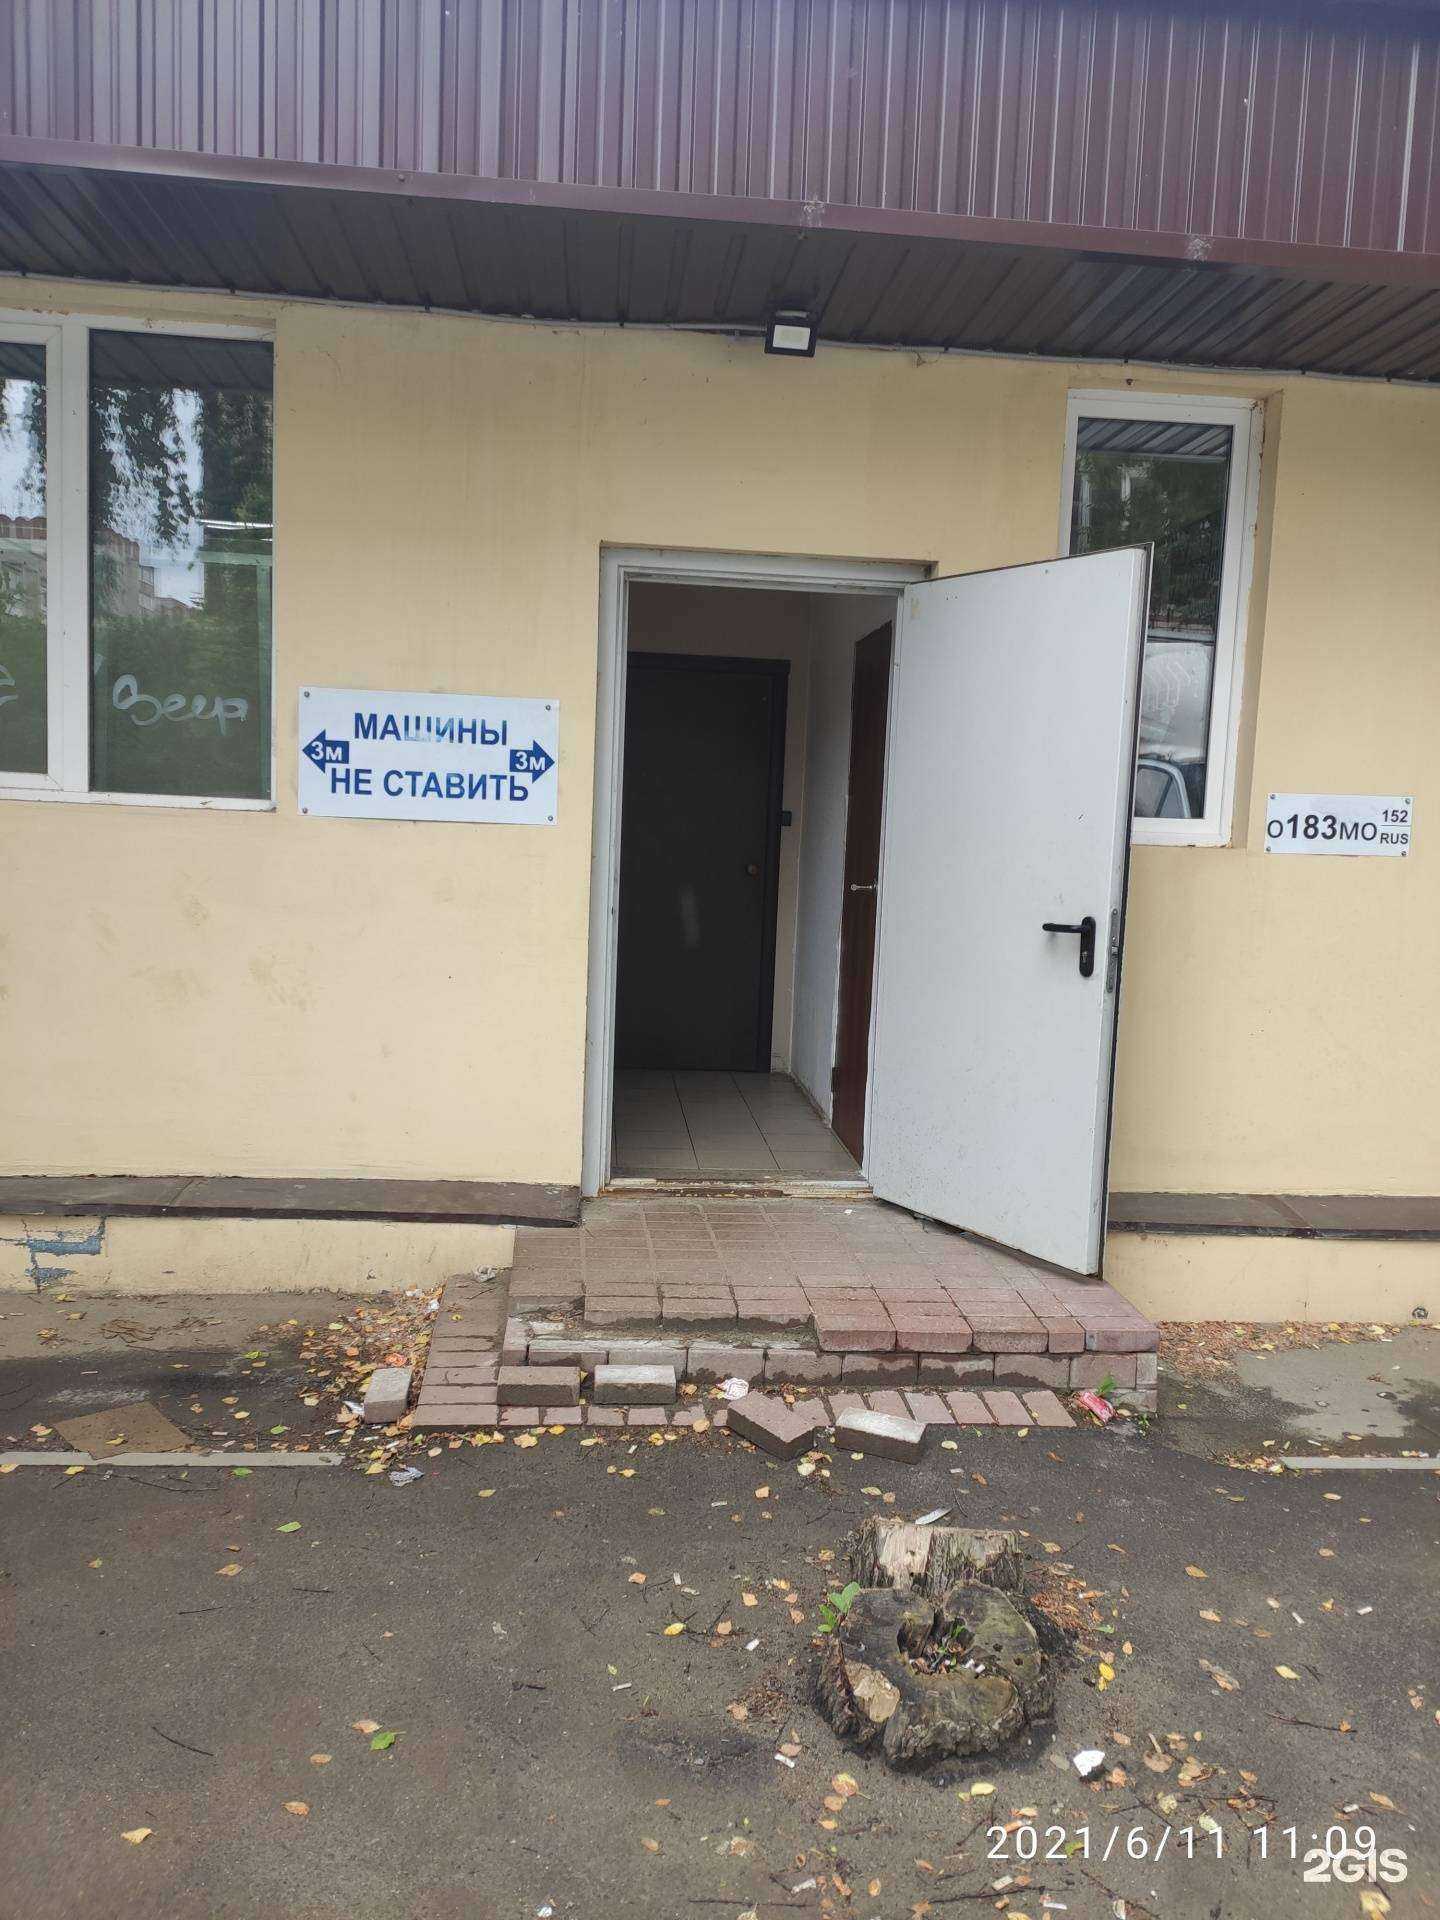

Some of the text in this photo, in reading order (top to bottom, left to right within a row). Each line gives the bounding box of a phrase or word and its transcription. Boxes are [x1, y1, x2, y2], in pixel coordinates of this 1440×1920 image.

[354, 712, 508, 746] МАШИНЫ
[331, 767, 529, 802] НЕ СТАВИТЬ
[1382, 809, 1408, 823] 152
[1379, 832, 1409, 845] RUS
